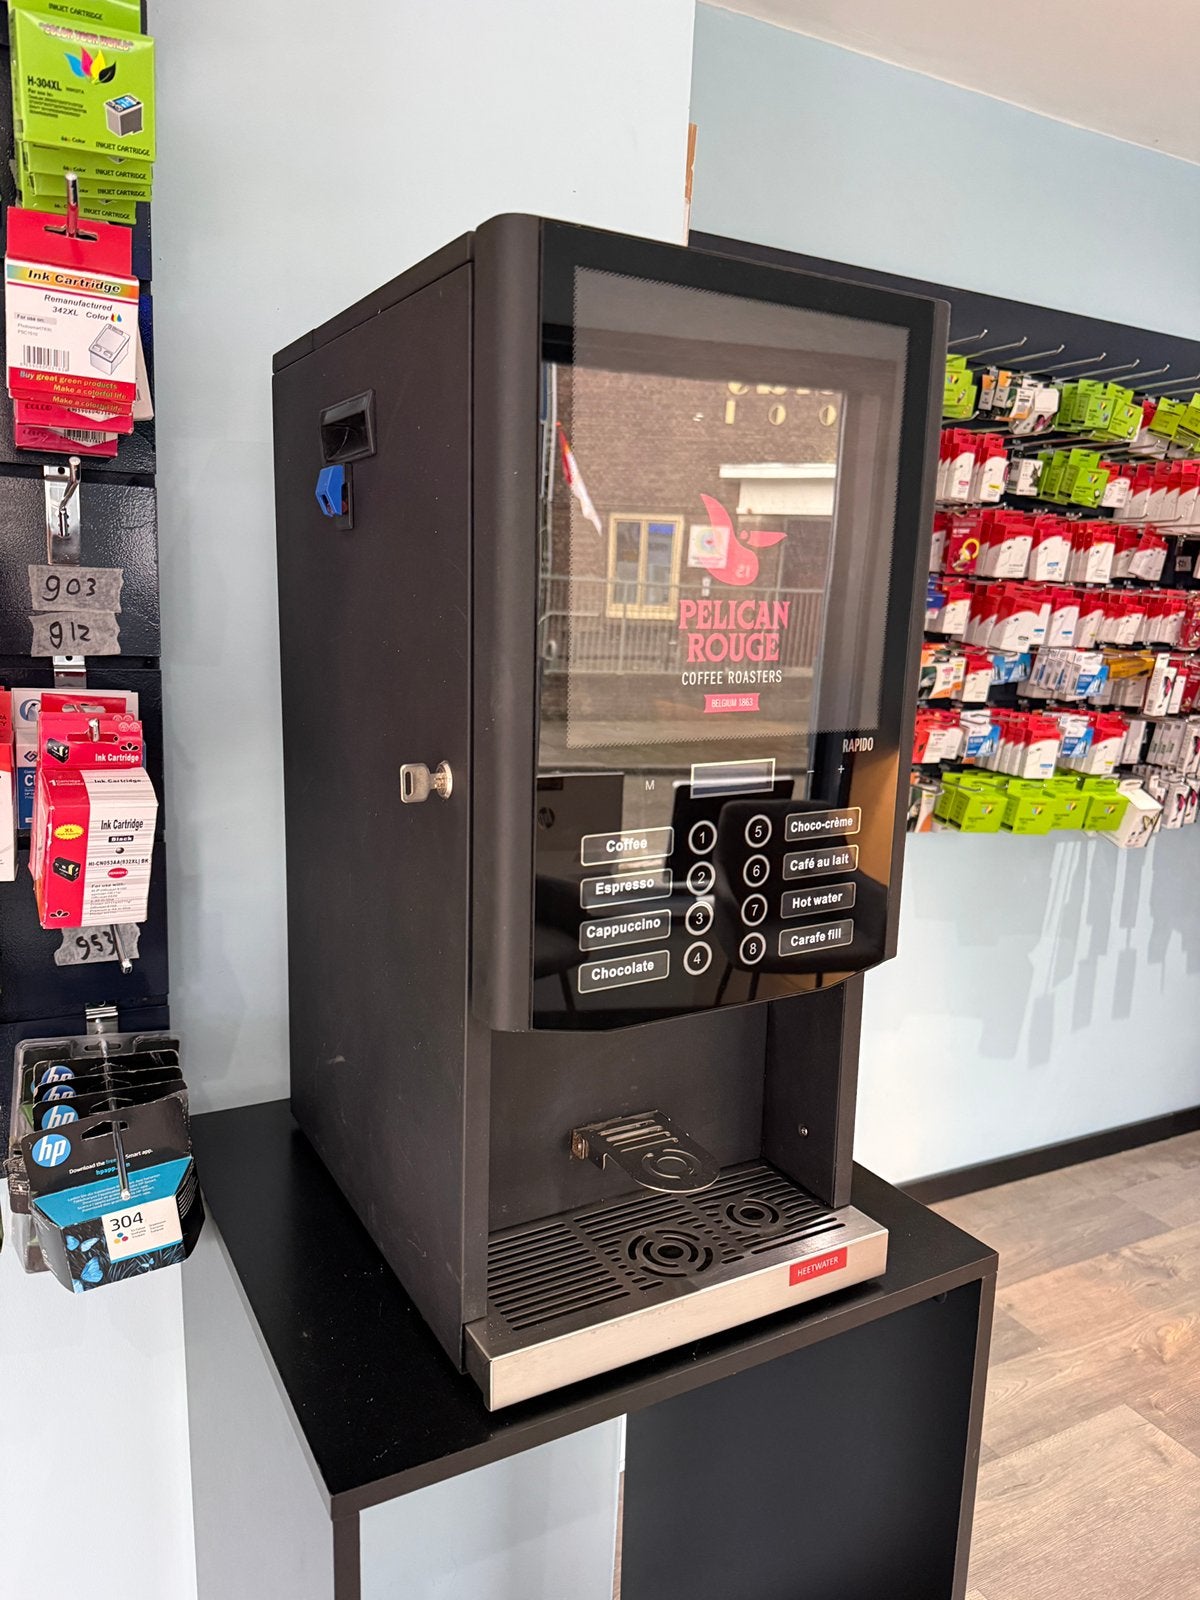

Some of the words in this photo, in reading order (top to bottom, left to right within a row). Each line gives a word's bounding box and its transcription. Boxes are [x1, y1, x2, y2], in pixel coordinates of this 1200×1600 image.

[49, 3, 68, 13] INKJET
[70, 7, 103, 20] CARTRIDGE
[27, 75, 63, 91] H-304XL
[95, 141, 116, 150] INKJET
[116, 145, 151, 157] CARTRIDGE
[95, 168, 116, 177] INKJET
[116, 171, 147, 180] CARTRIDGE
[83, 207, 101, 216] INKJET
[101, 210, 130, 219] CARTRIDGE
[28, 270, 50, 281] Ink
[55, 274, 120, 293] Cartridge
[44, 294, 113, 311] Remanufactured
[52, 306, 79, 317] 342XL
[85, 311, 110, 321] Color
[20, 370, 35, 380] Buy
[36, 373, 58, 383] great
[59, 376, 85, 385] green
[83, 381, 117, 390] products
[53, 384, 75, 393] Make
[83, 388, 113, 398] colorful
[52, 396, 73, 404] Make
[81, 400, 109, 411] colorful
[42, 575, 97, 600] 903
[678, 599, 791, 630] PELICAN
[49, 621, 91, 649] 912
[687, 633, 780, 663] ROUGE
[681, 671, 723, 685] COFFEE
[728, 669, 783, 684] ROASTERS
[711, 699, 737, 708] BELGIUM
[738, 697, 754, 707] 1863
[842, 738, 874, 753] RAPIDO
[95, 753, 106, 761] Ink
[107, 753, 139, 763] Cartridge
[645, 780, 655, 791] M
[101, 820, 111, 830] Ink
[113, 818, 144, 831] Cartridge
[754, 825, 763, 838] 5
[790, 815, 854, 833] Choco-crème
[606, 838, 648, 853] Coffee
[699, 831, 706, 844] 1
[752, 864, 760, 877] 6
[790, 857, 815, 872] Café
[816, 858, 831, 869] au
[832, 853, 849, 865] lait
[697, 871, 706, 884] 2
[595, 877, 655, 896] Espresso
[792, 896, 811, 909] Hot
[813, 891, 843, 905] water
[751, 904, 759, 916] 7
[695, 912, 704, 925] 3
[586, 917, 661, 940] Cappuccino
[76, 931, 115, 960] 953
[790, 932, 826, 947] Carafe
[827, 928, 842, 941] fill
[749, 943, 757, 955] 8
[693, 952, 702, 965] 4
[591, 960, 655, 981] Chocolate
[46, 1066, 73, 1083] h
[48, 1086, 75, 1101] h
[38, 1135, 67, 1167] hp
[69, 1163, 96, 1174] Download
[125, 1150, 141, 1159] Smart
[109, 1212, 143, 1232] 304
[797, 1256, 839, 1277] HEETWATER
